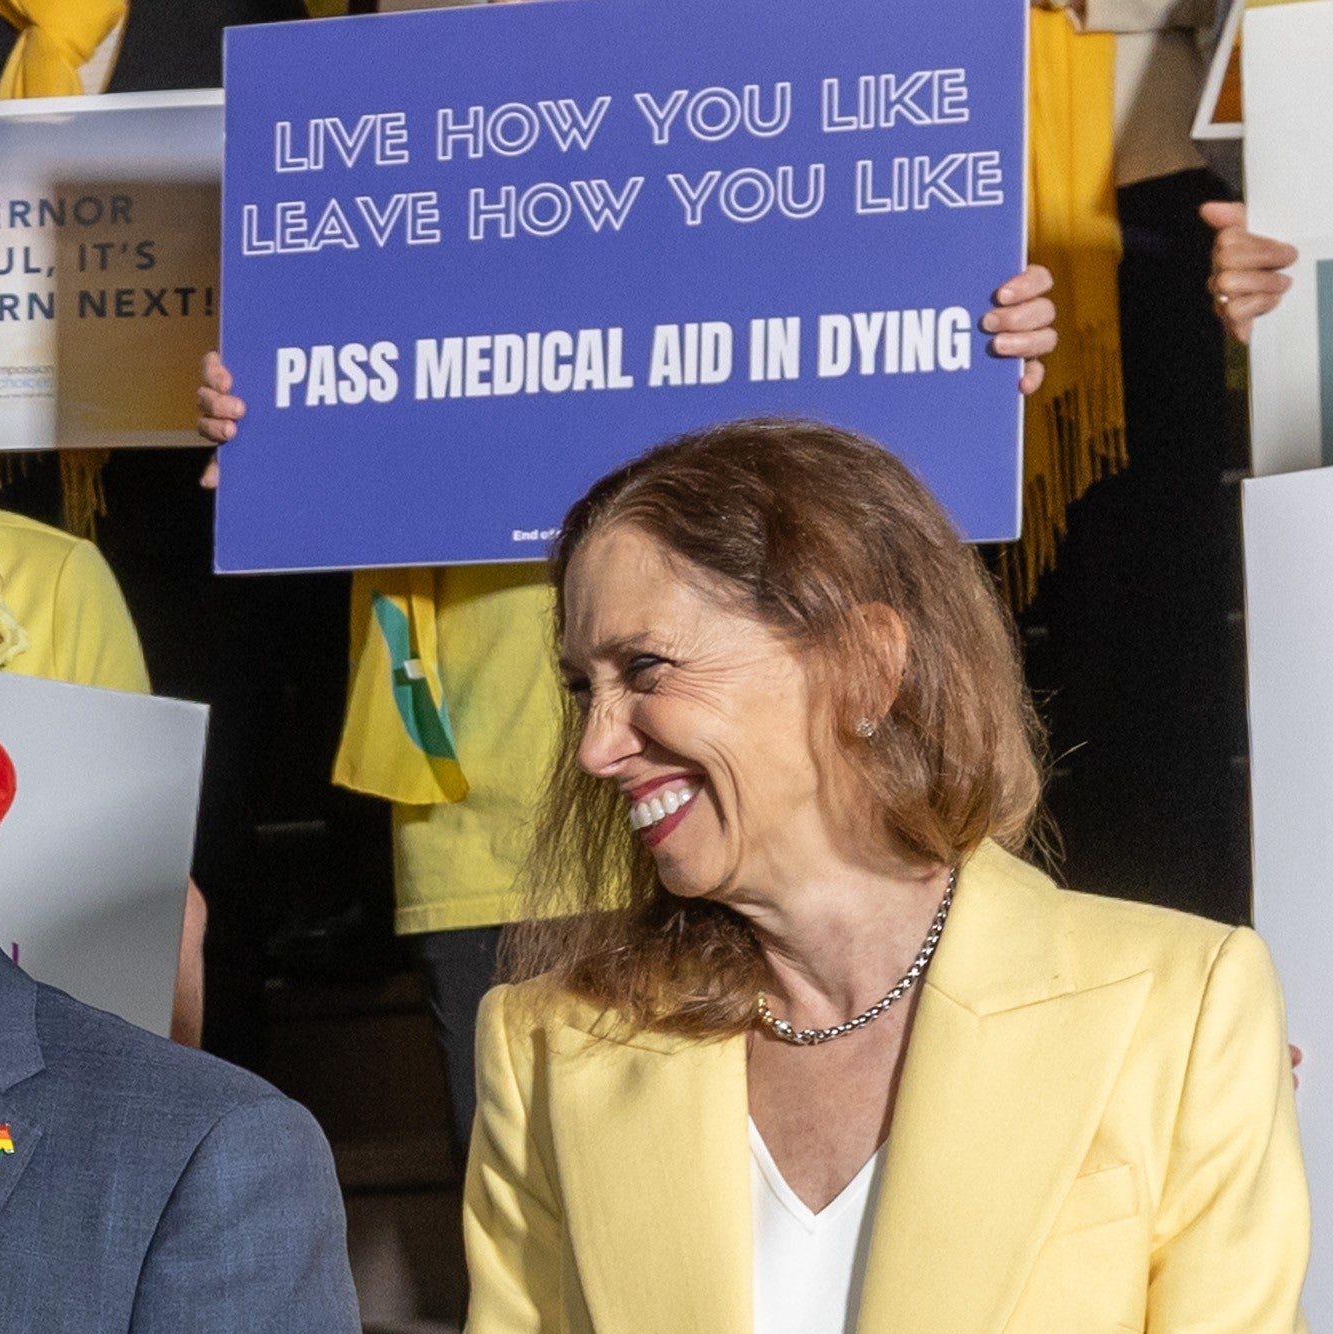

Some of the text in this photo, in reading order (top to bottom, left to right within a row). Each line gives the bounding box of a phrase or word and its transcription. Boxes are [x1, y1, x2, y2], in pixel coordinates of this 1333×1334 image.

[275, 67, 970, 172] LIVE HOW YOU LIKE
[242, 151, 1005, 256] LEAVE HOW YOU LIKE
[78, 240, 157, 273] IT'S
[78, 287, 214, 318] NEXT!
[276, 306, 972, 408] PASS MEDICAL AID IN DYING
[512, 528, 539, 541] End
